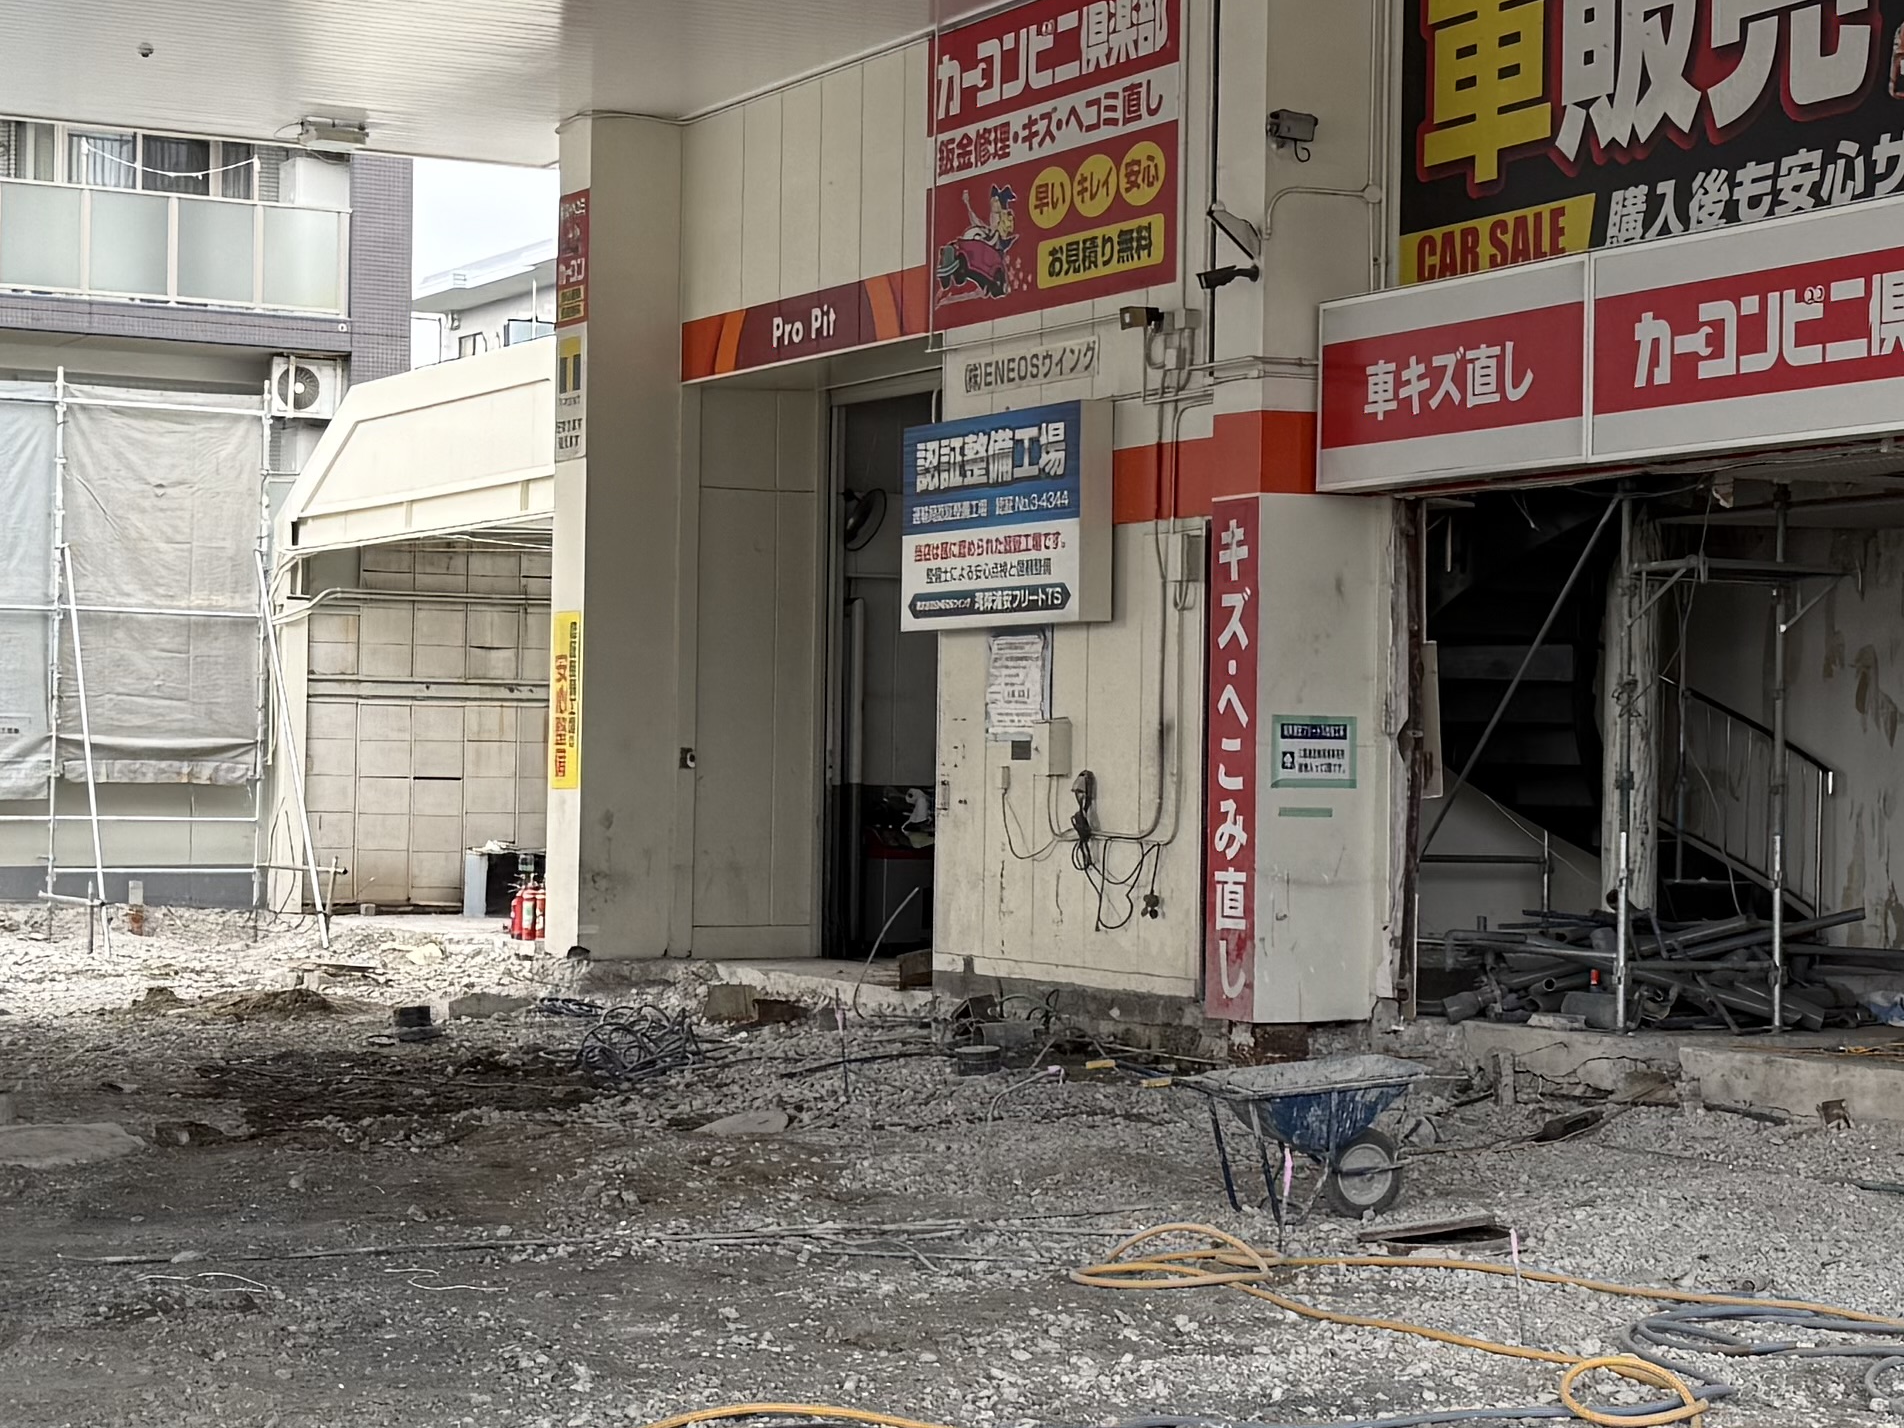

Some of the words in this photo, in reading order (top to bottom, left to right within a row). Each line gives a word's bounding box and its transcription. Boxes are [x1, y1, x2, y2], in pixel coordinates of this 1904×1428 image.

[1034, 181, 1066, 215] 早い
[1076, 166, 1113, 204] キレイ
[1124, 154, 1159, 194] 安心
[1048, 222, 1153, 278] お見積り無料
[1417, 226, 1480, 282] CAR
[1489, 206, 1566, 269] SALE
[772, 315, 804, 348] Pro
[810, 305, 837, 341] Pit
[1363, 339, 1534, 421] 車キズ直し
[916, 421, 1066, 493] 認証整備工場
